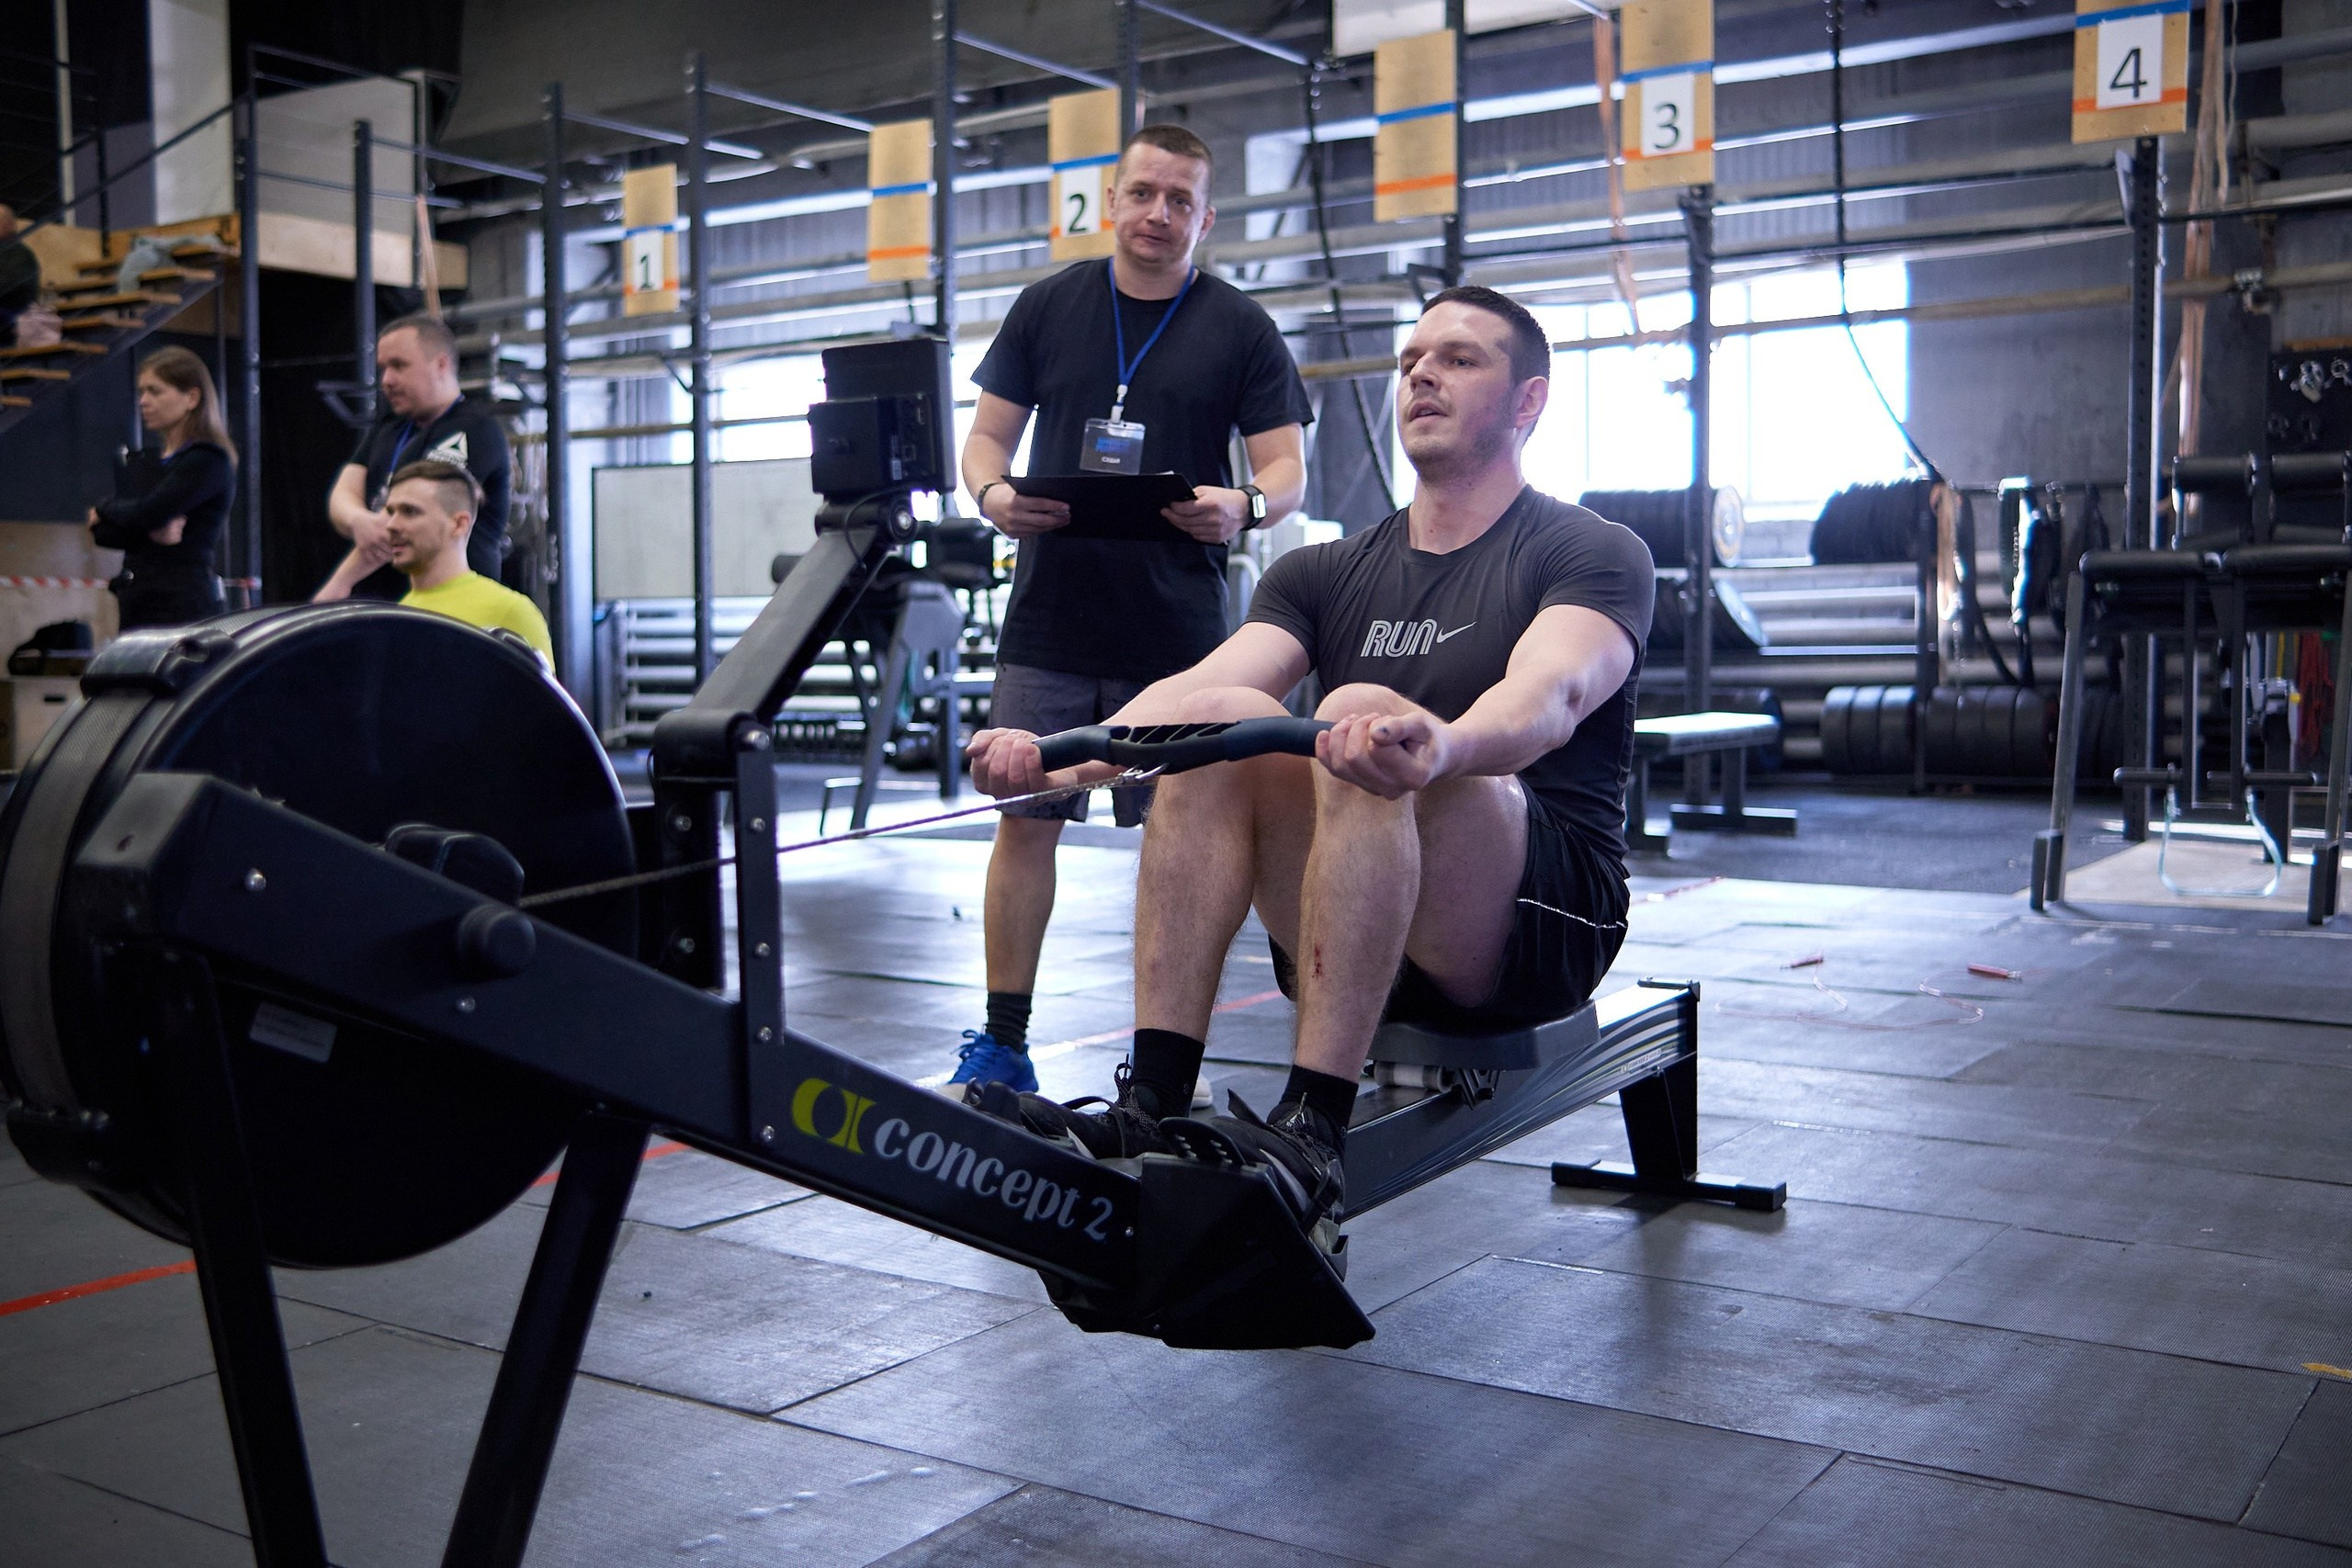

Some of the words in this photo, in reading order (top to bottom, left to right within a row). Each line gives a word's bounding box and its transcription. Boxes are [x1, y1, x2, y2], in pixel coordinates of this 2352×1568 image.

[2109, 48, 2148, 98] 4
[1655, 103, 1680, 150] 3
[1068, 193, 1088, 233] 2
[639, 254, 653, 289] 1
[1360, 618, 1438, 658] RUN
[874, 1117, 1081, 1228] concept
[1084, 1196, 1114, 1241] 2
